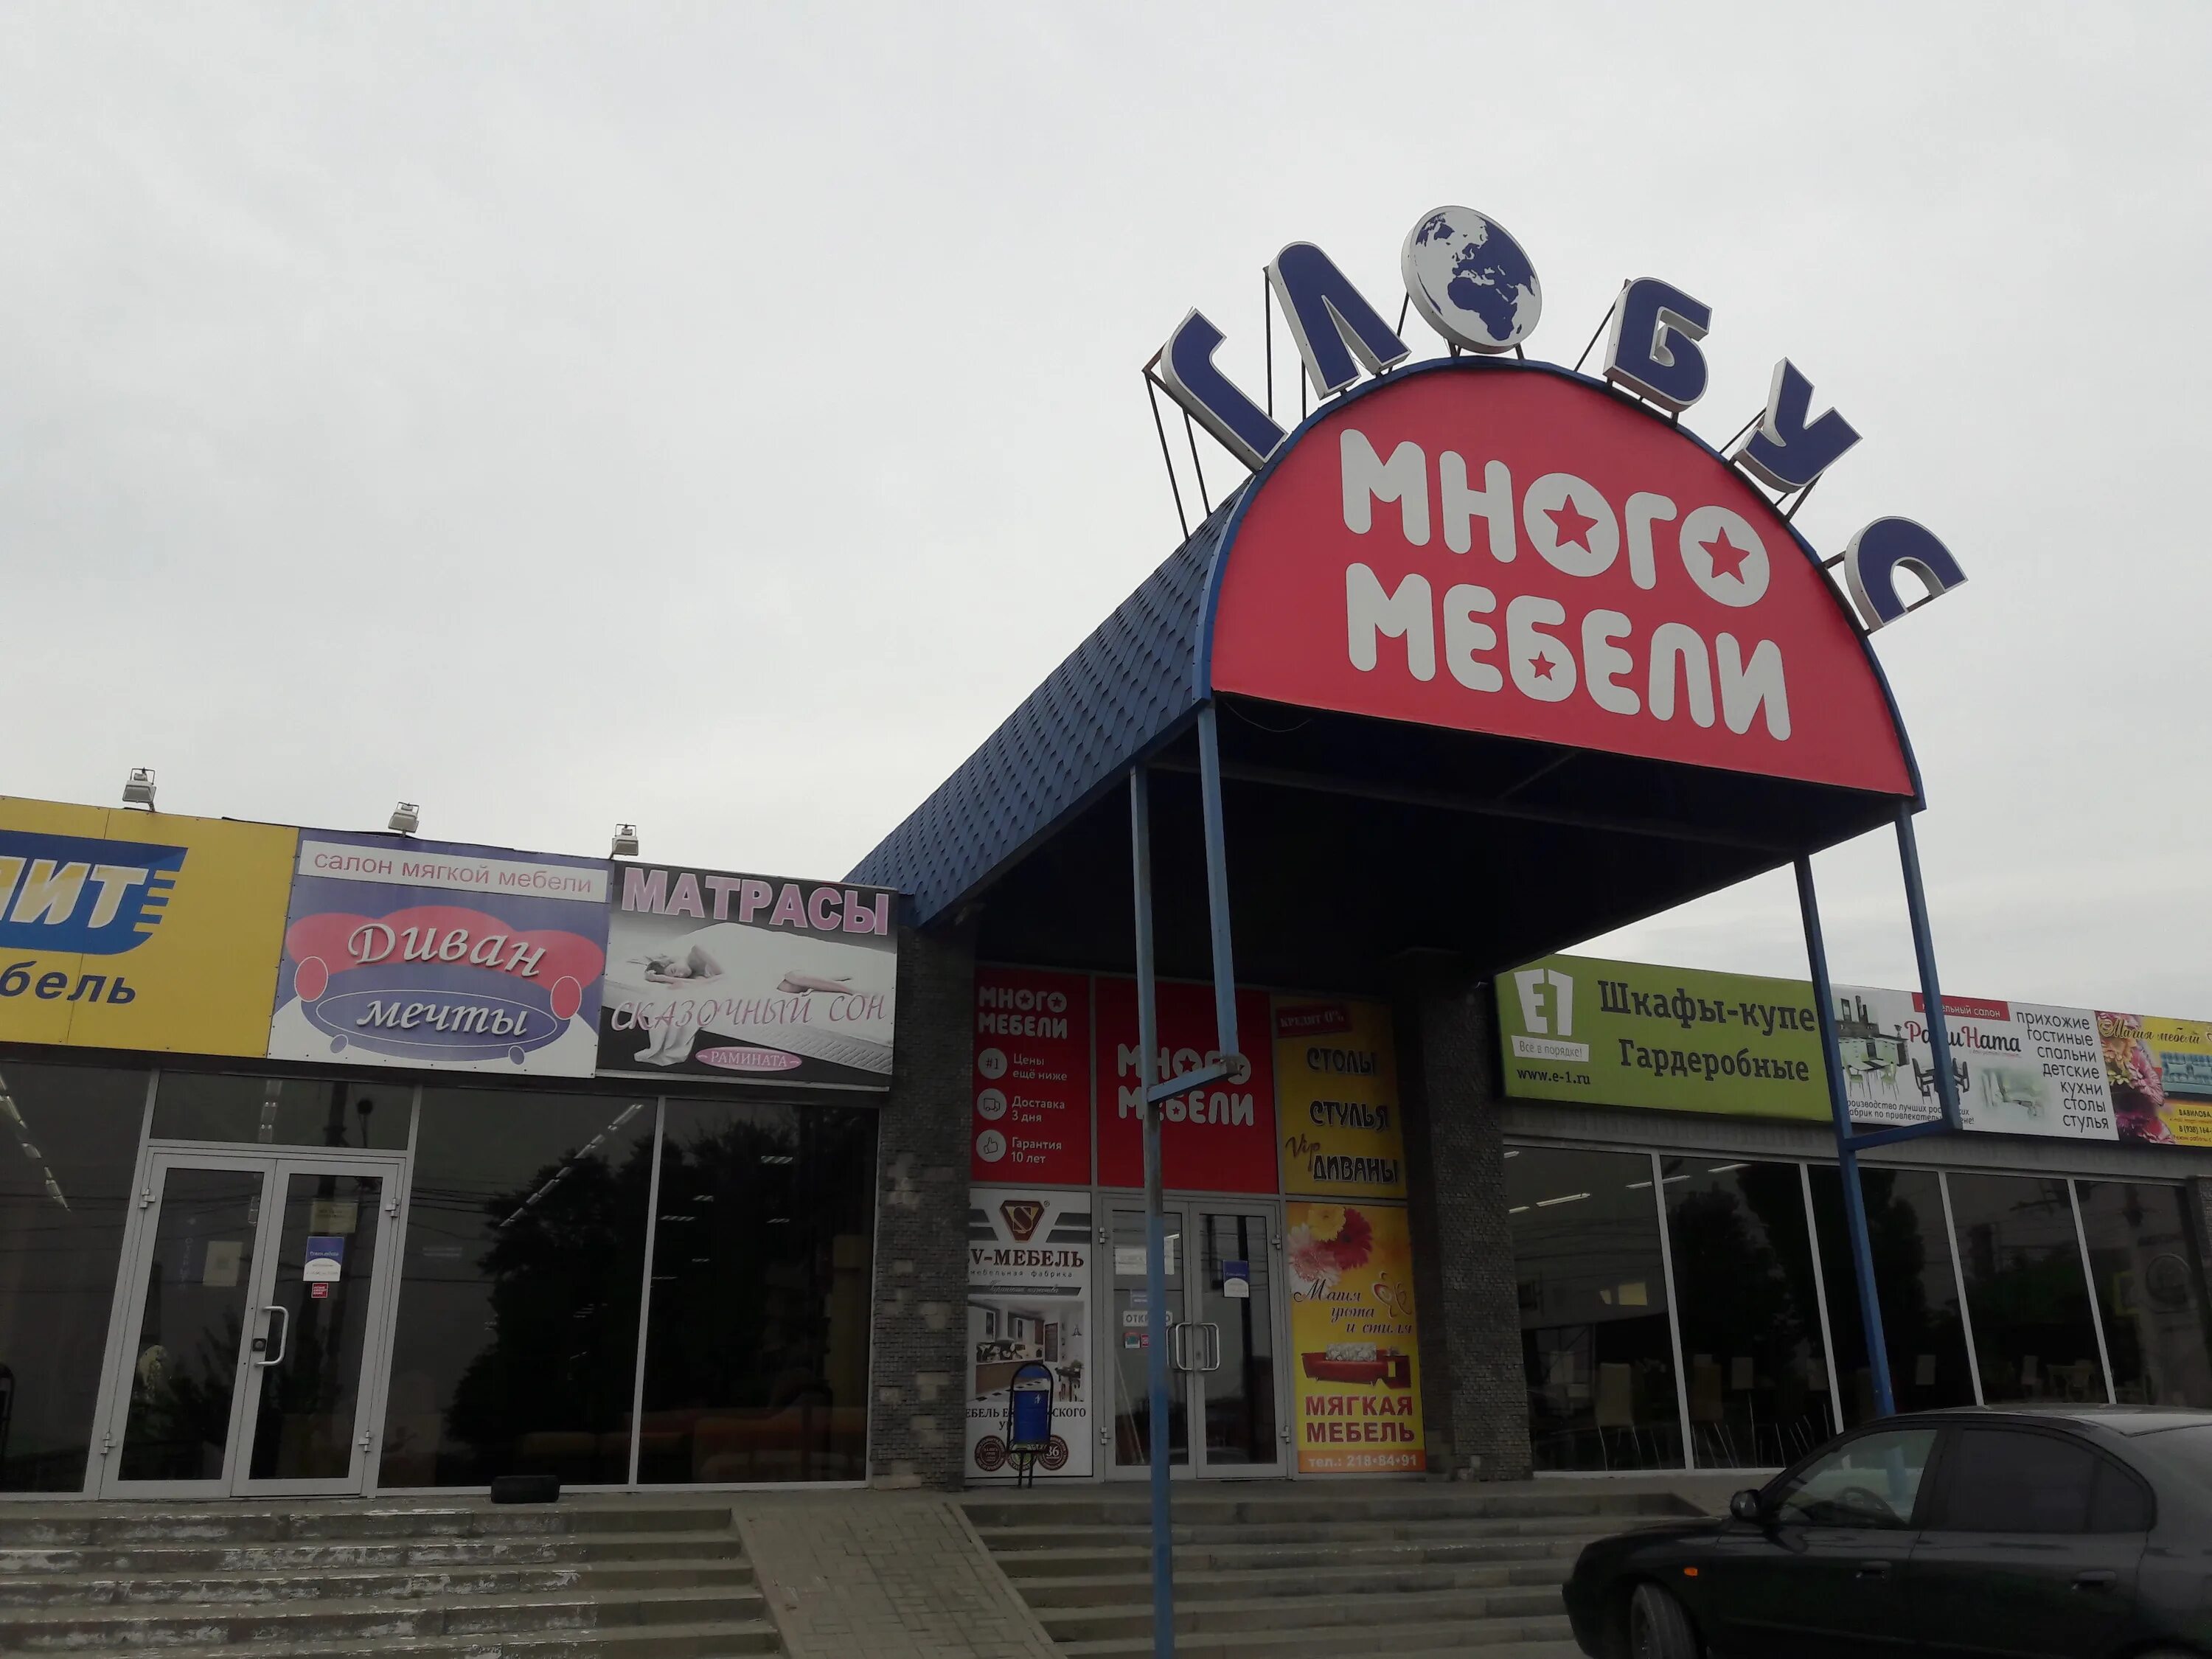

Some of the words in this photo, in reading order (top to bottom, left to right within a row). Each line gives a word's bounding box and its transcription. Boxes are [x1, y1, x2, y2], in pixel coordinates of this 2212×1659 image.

[1340, 428, 1770, 608] МНОГО
[1345, 563, 1791, 741] МЕБЕЛИ
[314, 852, 392, 874] салон
[402, 861, 490, 884] мягкой
[498, 871, 591, 894] мебели
[620, 866, 890, 936] МАТРАСЫ
[348, 923, 546, 978] Диван
[978, 986, 1068, 1013] МНОГО
[1598, 980, 1816, 1035] Шкафы-купе
[356, 1000, 528, 1037] мечты
[611, 992, 813, 1031] СКАЗОЧНЫЙ
[829, 994, 887, 1023] СОН
[1974, 1008, 2000, 1018] салон
[978, 1012, 1068, 1040] МЕБЕЛИ
[1280, 1015, 1321, 1028] КРЕДИТ
[2017, 1012, 2090, 1030] прихожие
[2098, 1018, 2154, 1039] Магия
[1904, 1020, 2022, 1052] РаиНата
[2027, 1029, 2093, 1046] гостиные
[710, 1051, 787, 1068] РАМИНАТА
[1013, 1053, 1045, 1066] Цены
[1537, 1045, 1543, 1054] в
[1545, 1046, 1582, 1057] порядке!
[2037, 1046, 2096, 1062] спальни
[985, 1057, 999, 1069] #1
[1306, 1046, 1377, 1075] СТОЛЫ
[1618, 1038, 1809, 1082] Гардеробные
[1012, 1068, 1036, 1080] ещё
[1038, 1072, 1068, 1081] ниже
[1517, 1069, 1591, 1085] www.e-1.ru
[2043, 1063, 2100, 1079] детские
[2061, 1081, 2103, 1098] кухни
[1012, 1095, 1065, 1109] Доставка
[1119, 1085, 1254, 1127] МБЕЛИ
[1847, 1099, 1897, 1110] роизводство
[1899, 1104, 1927, 1113] лучших
[2064, 1098, 2106, 1113] столы
[1012, 1110, 1018, 1121] 3
[1021, 1113, 1042, 1122] дня
[1310, 1100, 1389, 1132] СТУЛЬЯ
[1848, 1107, 1873, 1118] абрик
[1874, 1110, 1884, 1119] по
[2063, 1115, 2109, 1133] стулья
[1012, 1137, 1062, 1150] Гарантия
[1011, 1151, 1023, 1163] 10
[1026, 1155, 1046, 1164] лет
[1285, 1133, 1321, 1172] Vip
[1312, 1155, 1399, 1183] ДИВАНЫ
[1031, 1269, 1073, 1279] фабрика
[1293, 1279, 1361, 1302] Магия
[1332, 1307, 1374, 1324] уюта
[1346, 1324, 1355, 1333] и
[1363, 1324, 1412, 1334] стиля
[966, 1408, 999, 1417] ЕБЕЛЬ
[1305, 1396, 1413, 1416] МЯГКАЯ
[1307, 1422, 1415, 1442] МЕБЕЛЬ
